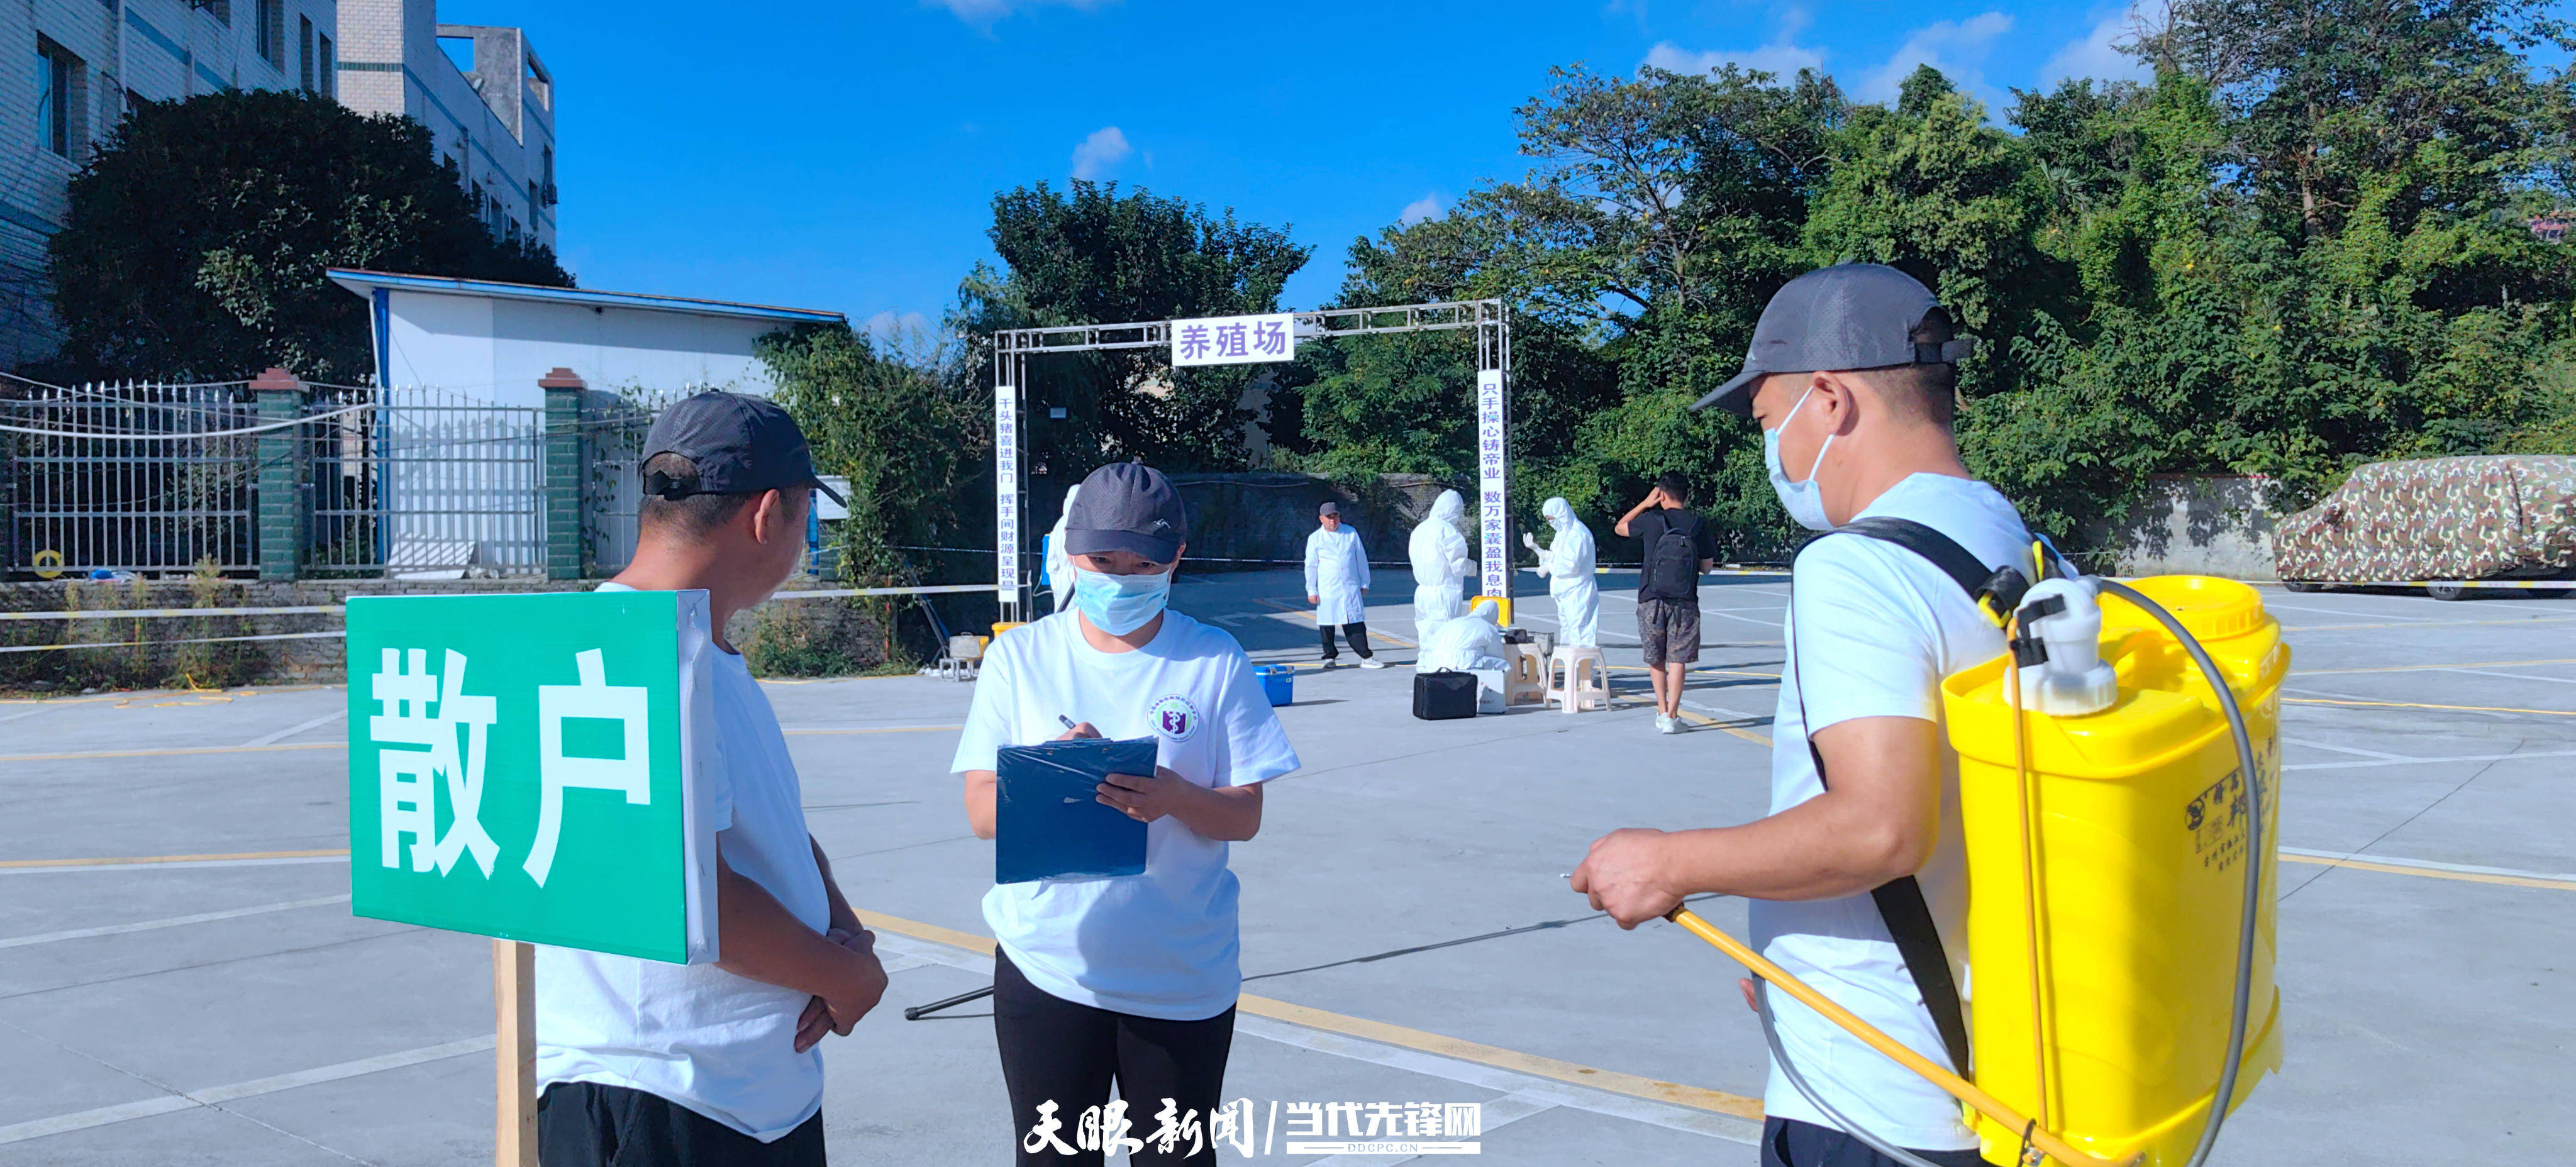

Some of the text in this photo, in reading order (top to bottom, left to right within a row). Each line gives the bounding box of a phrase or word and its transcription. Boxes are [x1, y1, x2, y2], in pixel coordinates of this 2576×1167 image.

[1180, 321, 1285, 360] 养殖场
[999, 398, 1014, 483] 千头猪喜进我门
[1481, 383, 1501, 479] 只手操心铸帝业
[370, 648, 651, 889] 散户
